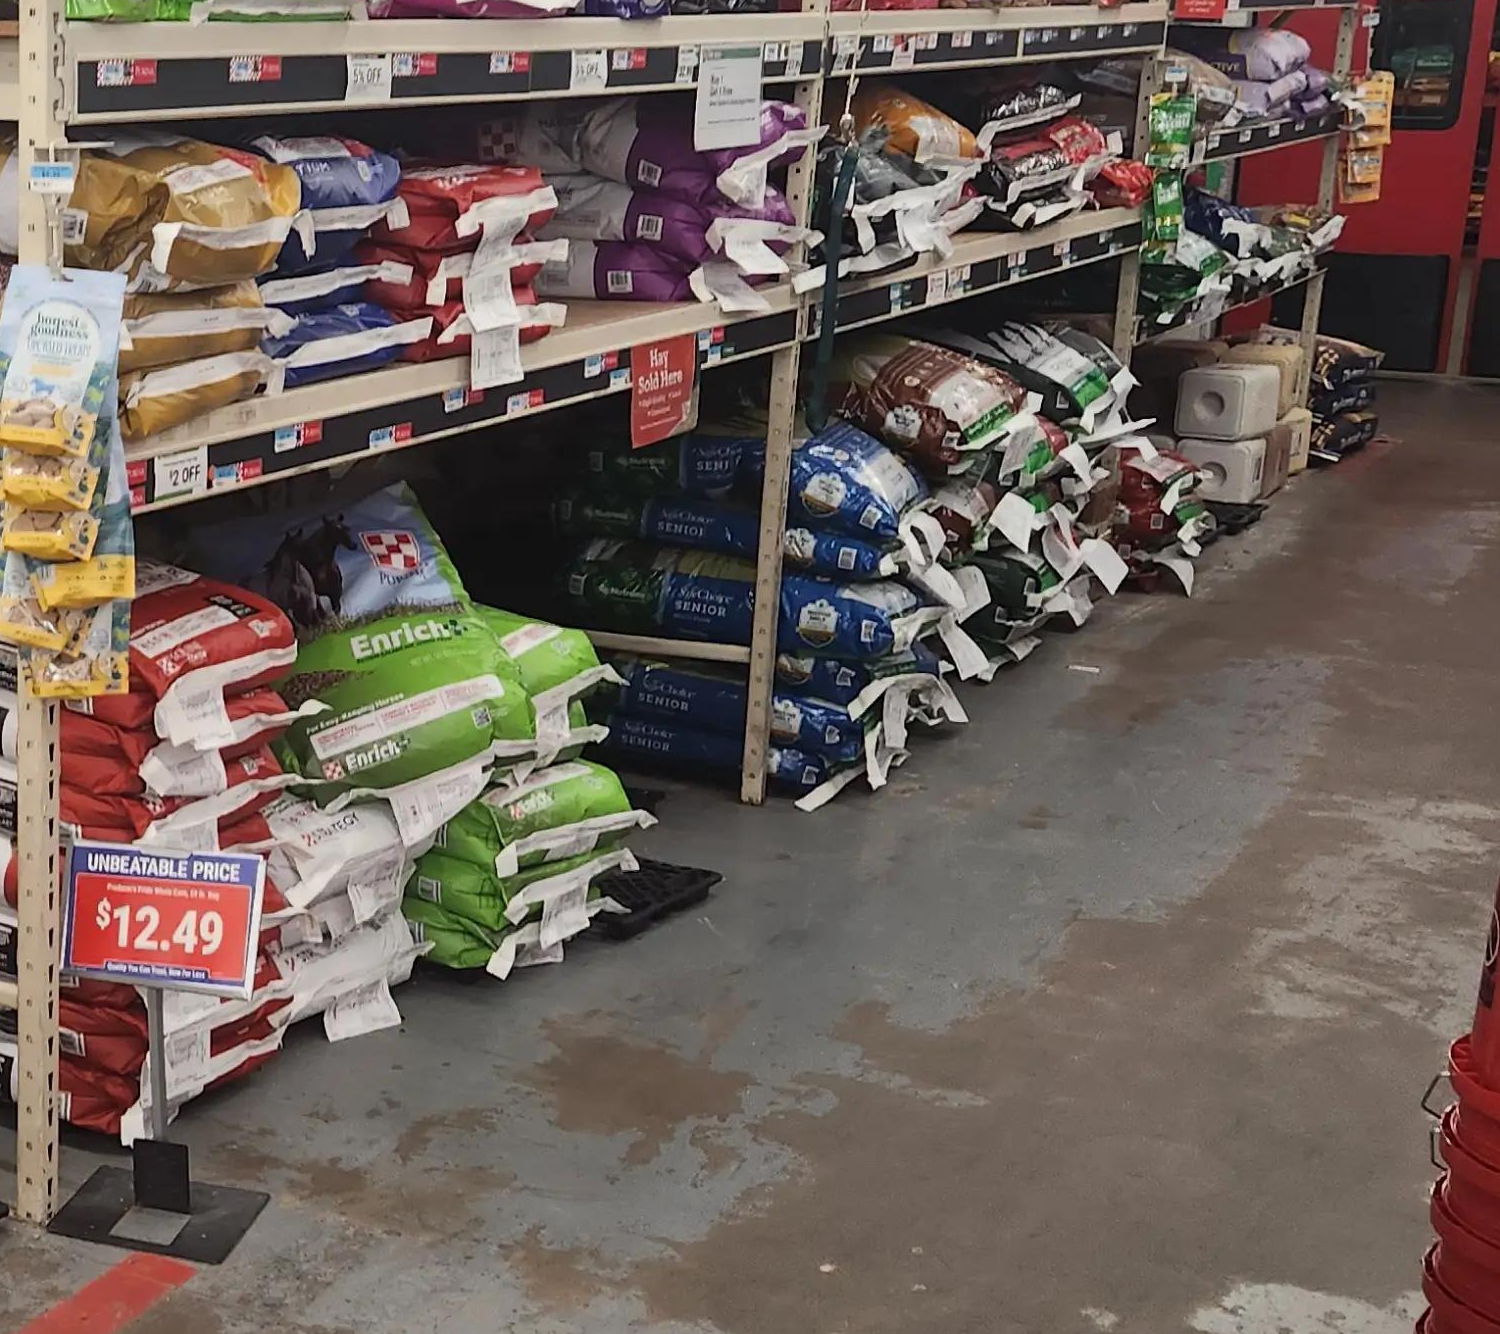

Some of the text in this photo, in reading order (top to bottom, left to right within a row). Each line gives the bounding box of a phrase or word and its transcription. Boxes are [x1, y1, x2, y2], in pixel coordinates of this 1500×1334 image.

[366, 66, 383, 83] OFF
[29, 323, 89, 340] goodness
[36, 312, 79, 330] honest
[650, 348, 670, 369] Hay
[638, 369, 683, 395] Sold Here
[182, 463, 201, 484] OFF
[673, 600, 727, 618] SENIOR
[351, 620, 446, 661] Enrich
[637, 692, 690, 712] SENIOR
[345, 740, 401, 772] Enrich
[87, 852, 241, 883] UNBEATABLE PRICE
[95, 897, 224, 956] $12.49
